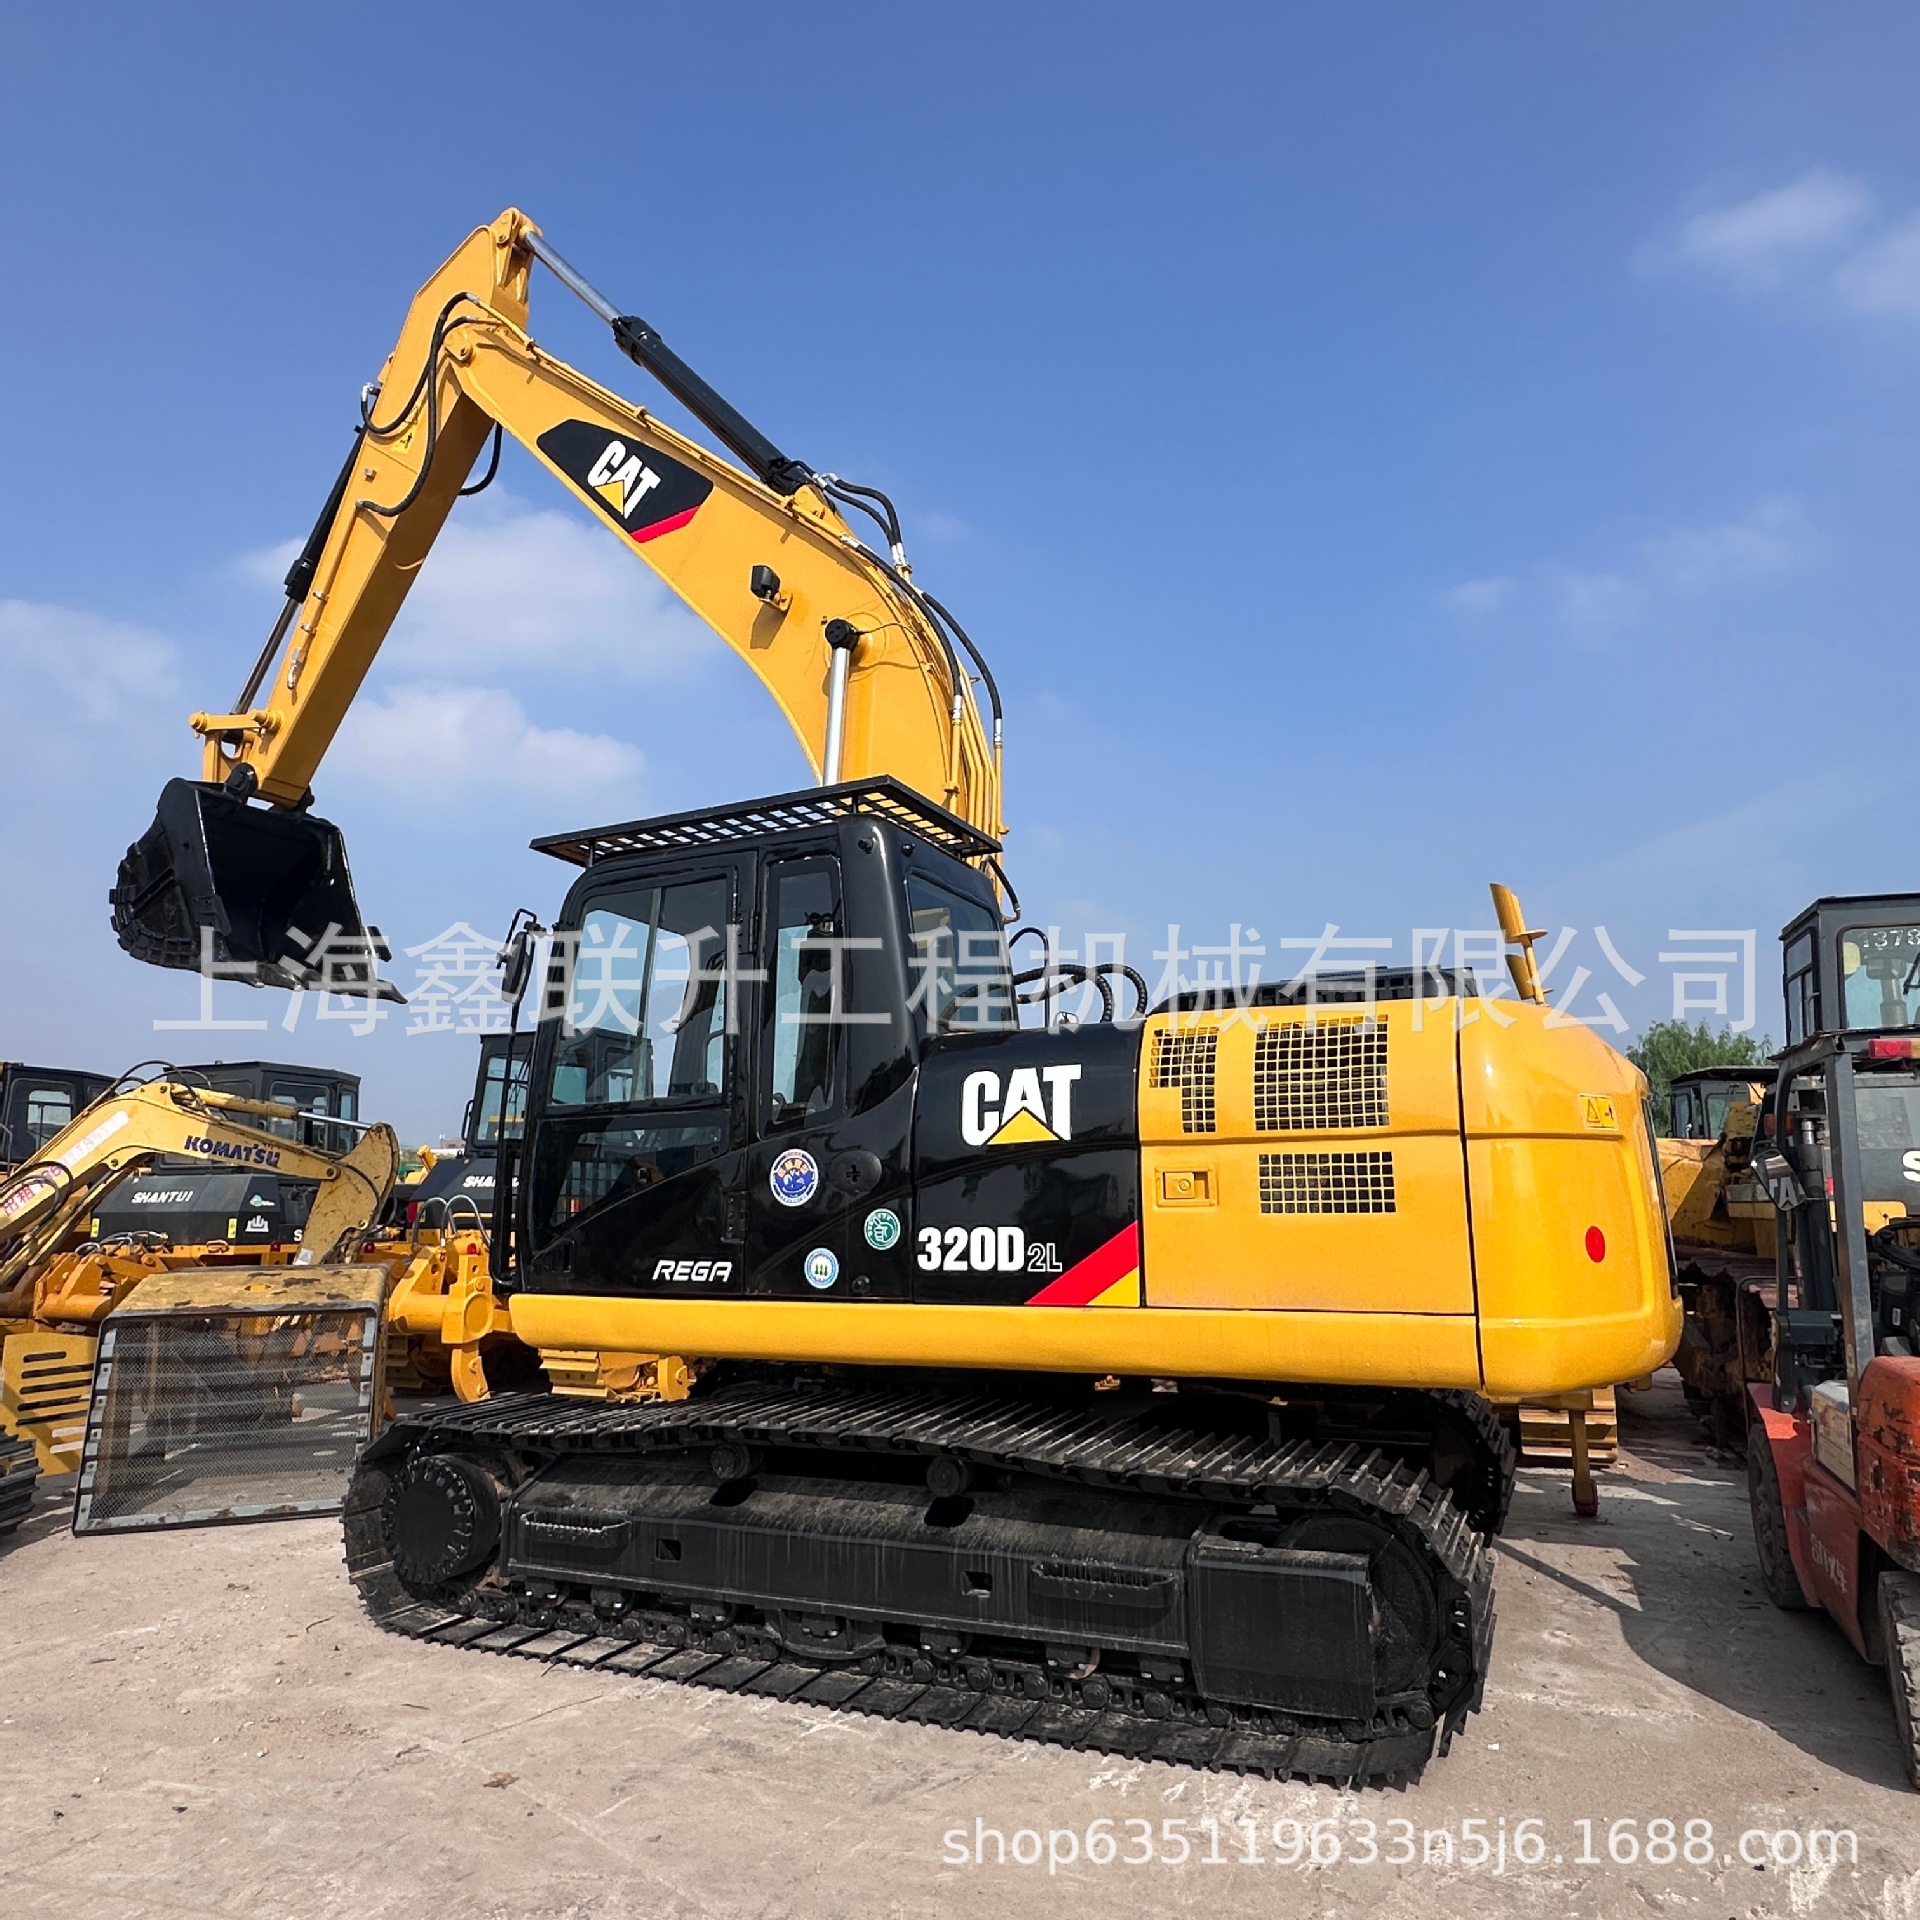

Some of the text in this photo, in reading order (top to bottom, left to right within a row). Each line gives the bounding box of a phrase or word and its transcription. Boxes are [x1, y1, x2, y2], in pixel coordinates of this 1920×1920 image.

[586, 440, 662, 520] CAT
[961, 1064, 1082, 1146] CAT
[184, 1135, 281, 1167] KOMATSU
[131, 1190, 194, 1204] SHANTUI
[652, 1259, 732, 1283] REGA
